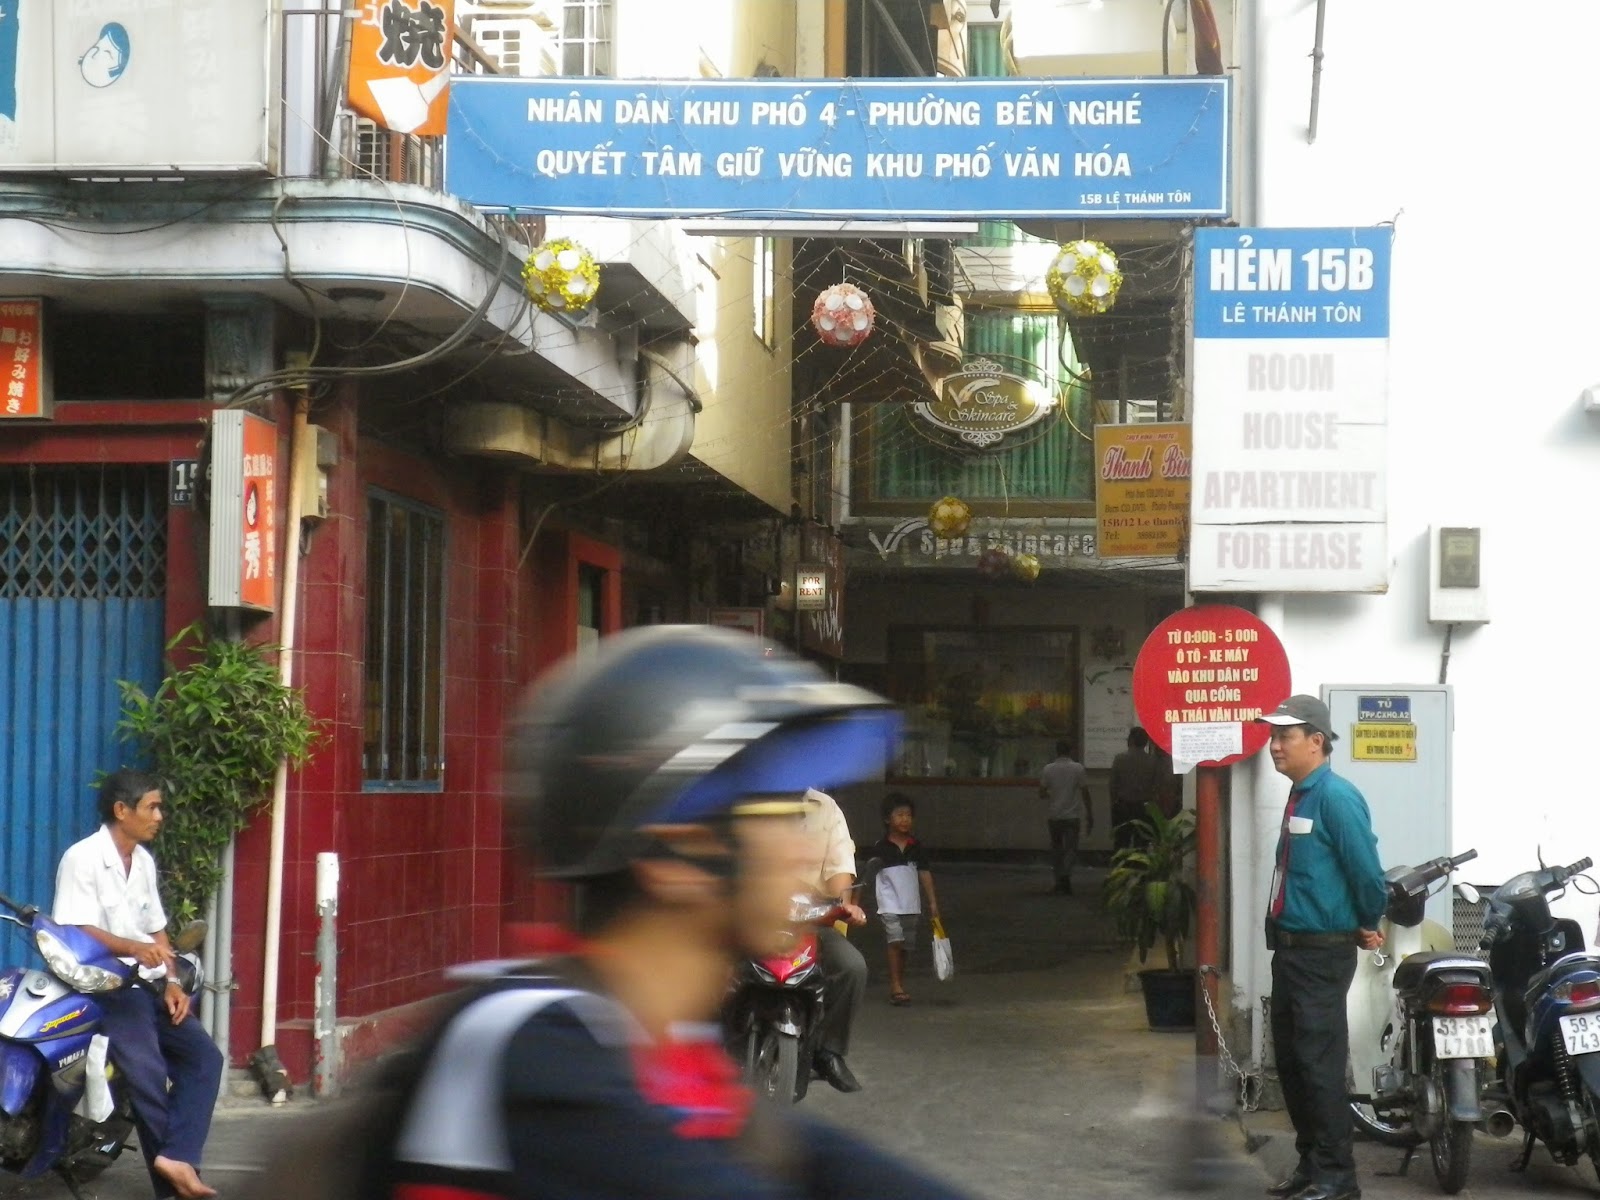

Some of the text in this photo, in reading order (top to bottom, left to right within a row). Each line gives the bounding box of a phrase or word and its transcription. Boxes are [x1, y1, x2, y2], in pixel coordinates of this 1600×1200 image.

[527, 91, 602, 123] NHÂN
[615, 93, 669, 124] DÂN
[684, 101, 740, 125] KHU
[752, 90, 812, 125] PHỐ
[819, 102, 837, 126] 4
[869, 93, 980, 126] PHƯỜNG
[996, 90, 1053, 125] BẾN
[1069, 92, 1142, 125] NGHÉ
[537, 141, 1132, 178] QUYẾT TÂM GIỮ VỮNG KHU PHỐ VĂN HÓA
[1080, 190, 1191, 204] 15B LÊ THÁNH TÔN
[1210, 234, 1374, 291] HẺM 15B
[1223, 301, 1361, 323] LÊ THÁNH TÔN
[1248, 353, 1334, 392] ROOM
[975, 390, 1008, 407] Spa
[949, 408, 1015, 421] Skincare
[1243, 412, 1338, 450] HOUSE
[1102, 444, 1191, 479] Thanh Bìn
[1204, 471, 1377, 510] APARTMENT
[1217, 531, 1362, 570] FOR LEASE
[802, 576, 820, 585] FOR
[799, 587, 823, 596] RENT
[1167, 629, 1182, 645] TỪ
[1183, 630, 1216, 644] 0:00h
[1176, 648, 1185, 664] Ô
[1186, 648, 1201, 663] TÔ
[1209, 650, 1222, 663] XE
[1225, 647, 1249, 662] MÁY
[1168, 668, 1190, 684] VÀO
[1192, 669, 1214, 683] KHU
[1216, 667, 1240, 682] DÂN
[1185, 685, 1241, 704] QUA CỔNG
[1165, 706, 1262, 723] 8A THÁI VĂN LUNG
